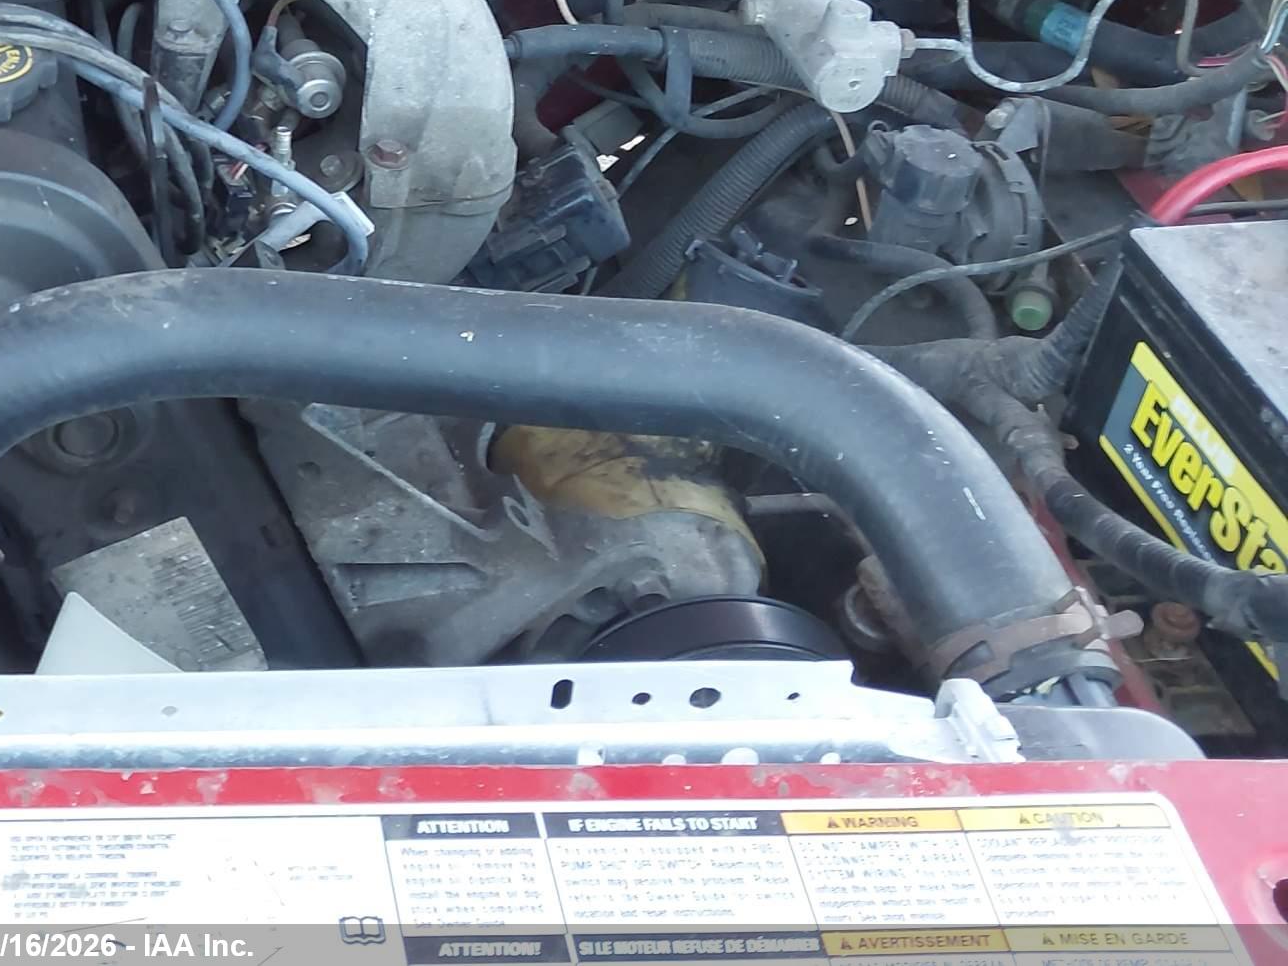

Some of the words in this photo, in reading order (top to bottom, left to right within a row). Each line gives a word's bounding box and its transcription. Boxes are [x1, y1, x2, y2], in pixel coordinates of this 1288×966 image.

[1123, 443, 1133, 454] 2
[568, 819, 585, 832] IF
[585, 819, 642, 831] ENGINE
[643, 818, 685, 831] FAILS
[687, 818, 709, 830] TO
[711, 817, 758, 830] START
[841, 816, 920, 828] WARNING
[1033, 811, 1105, 825] CAUTION
[417, 820, 509, 833] ATTENTION
[578, 941, 593, 956] SI
[595, 940, 612, 955] LE
[613, 939, 672, 955] MOTEUR
[673, 940, 724, 954] REFUSE
[725, 939, 745, 954] DE
[746, 935, 819, 953] DÉMARRER
[858, 934, 991, 949] AVERTISSEMENT
[1059, 933, 1099, 945] MISE
[1104, 932, 1127, 945] EN
[1131, 932, 1189, 945] GARDE
[439, 942, 542, 957] ATTENTION!
